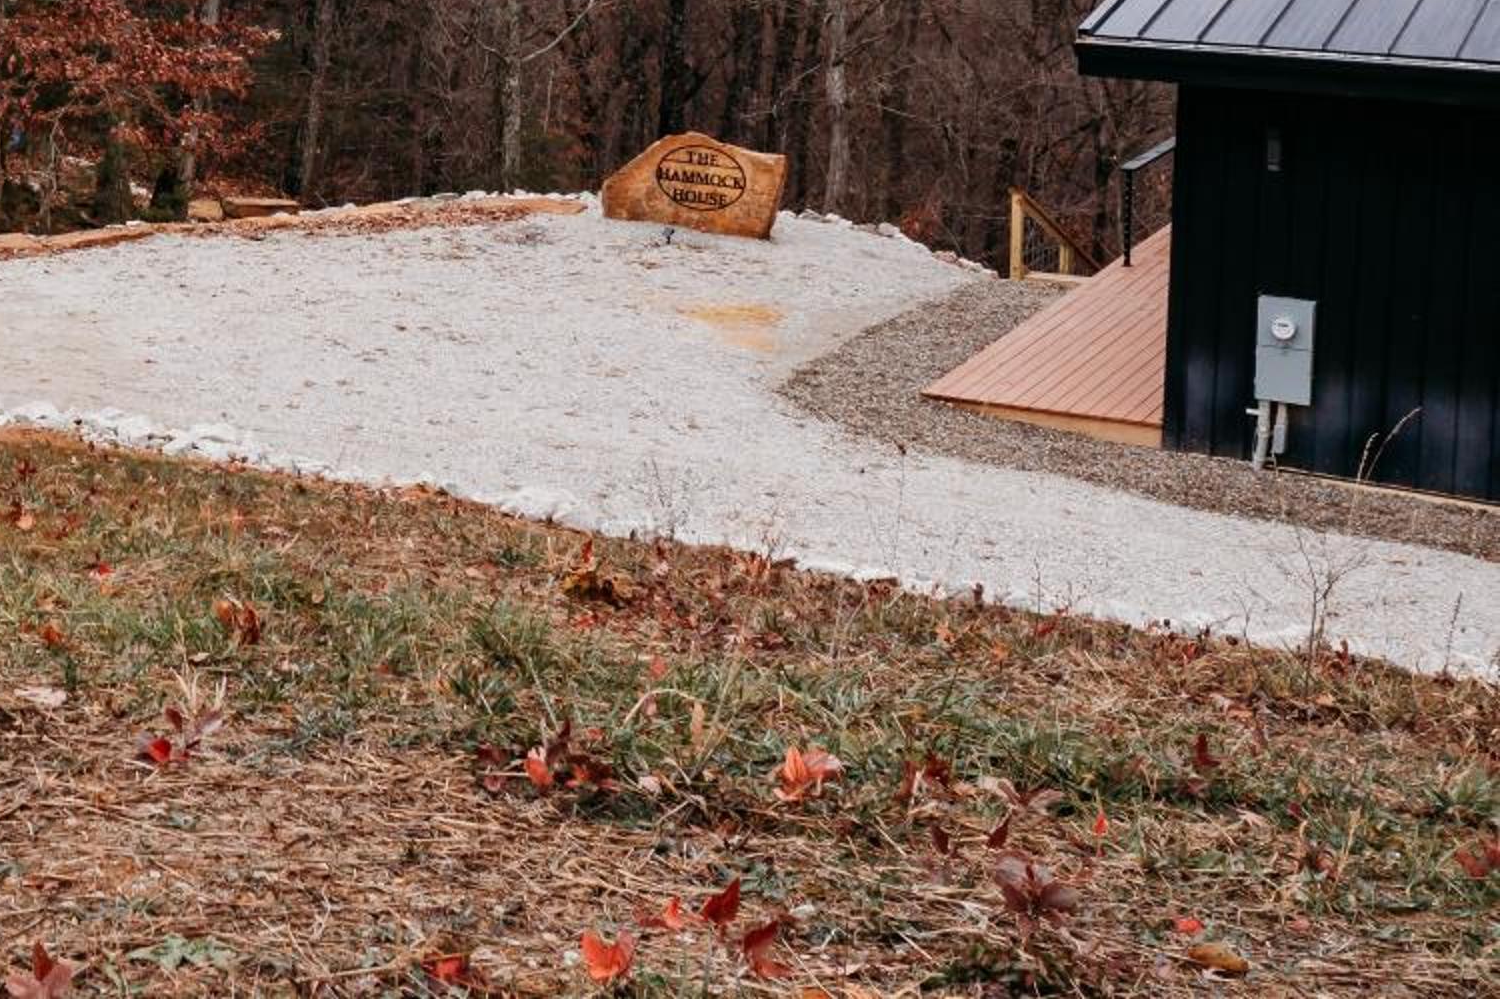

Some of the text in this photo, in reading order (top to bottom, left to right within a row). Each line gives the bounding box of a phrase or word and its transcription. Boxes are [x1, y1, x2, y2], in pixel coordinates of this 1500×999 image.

[687, 151, 719, 167] THE
[659, 167, 743, 189] HAMMOCK
[672, 188, 727, 206] HOUSE
